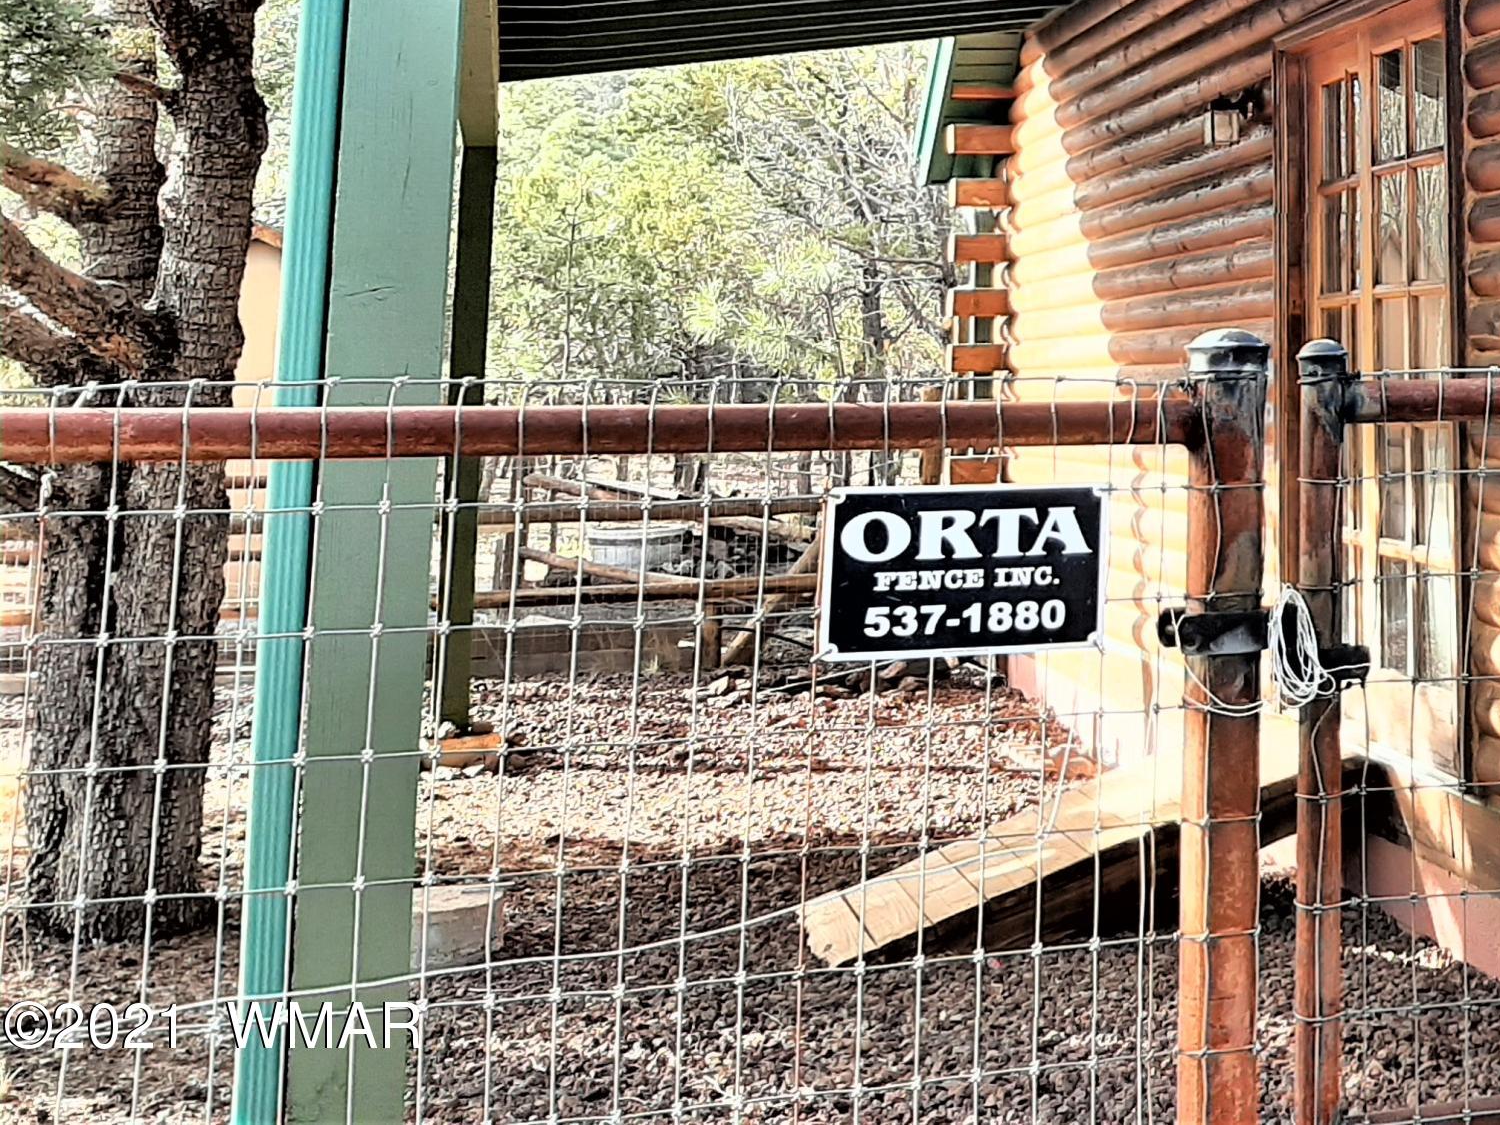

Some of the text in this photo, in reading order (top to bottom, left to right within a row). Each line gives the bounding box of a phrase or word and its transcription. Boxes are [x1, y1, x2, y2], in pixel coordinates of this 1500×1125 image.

[840, 506, 1093, 562] ORTA
[873, 566, 1060, 591] FENCE INC.
[863, 599, 1066, 637] 537-1880
